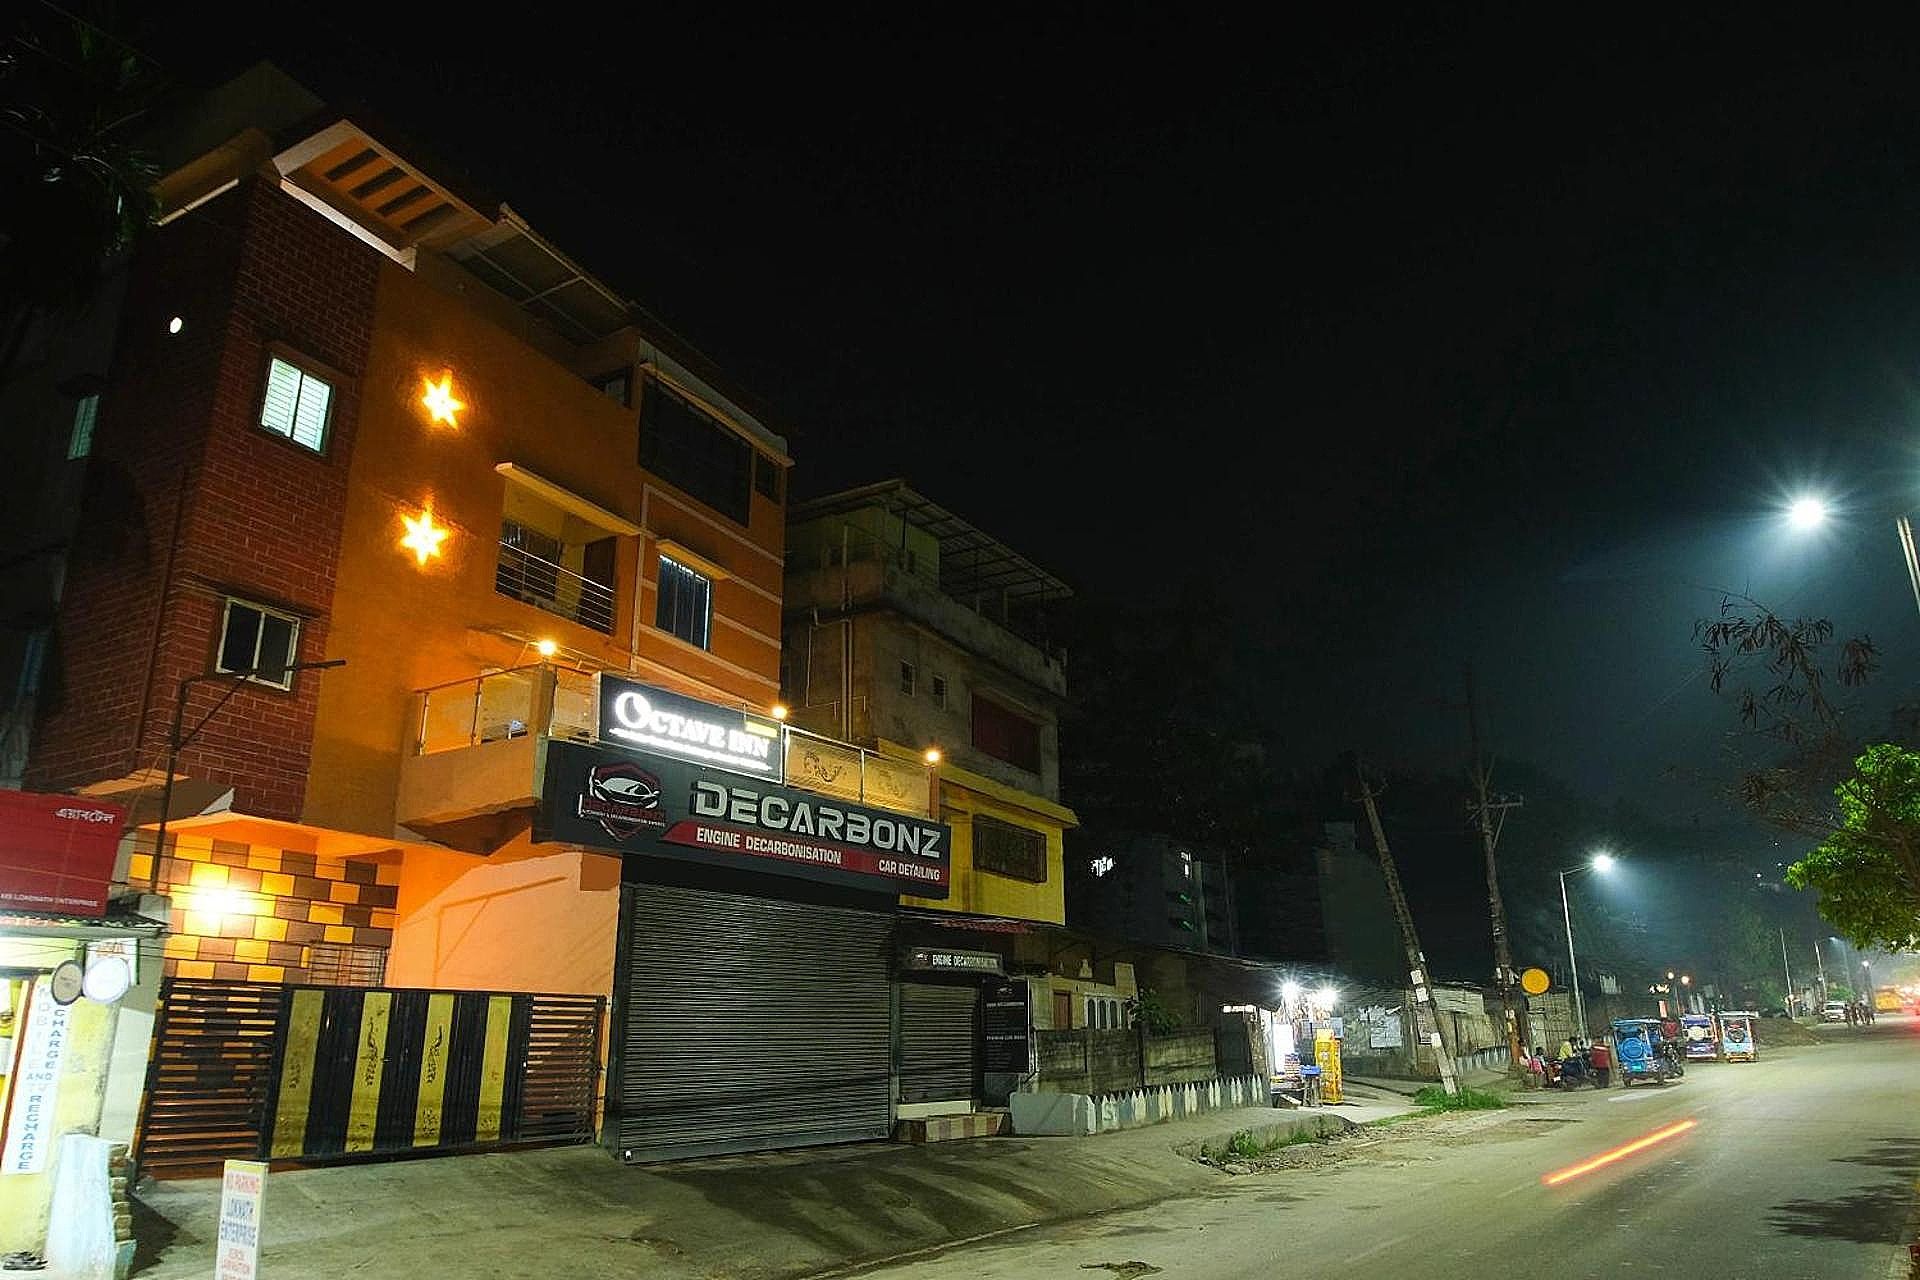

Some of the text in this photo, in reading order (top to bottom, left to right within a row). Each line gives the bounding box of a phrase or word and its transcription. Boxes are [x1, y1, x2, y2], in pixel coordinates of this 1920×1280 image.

[728, 730, 771, 758] INN
[694, 781, 941, 858] DECARBONZ
[696, 827, 941, 881] ENGINE DECARBONISATION CAR DETAILING
[45, 1008, 66, 1069] CHARGE
[26, 1071, 53, 1081] AND
[18, 1095, 42, 1170] RECHARGE
